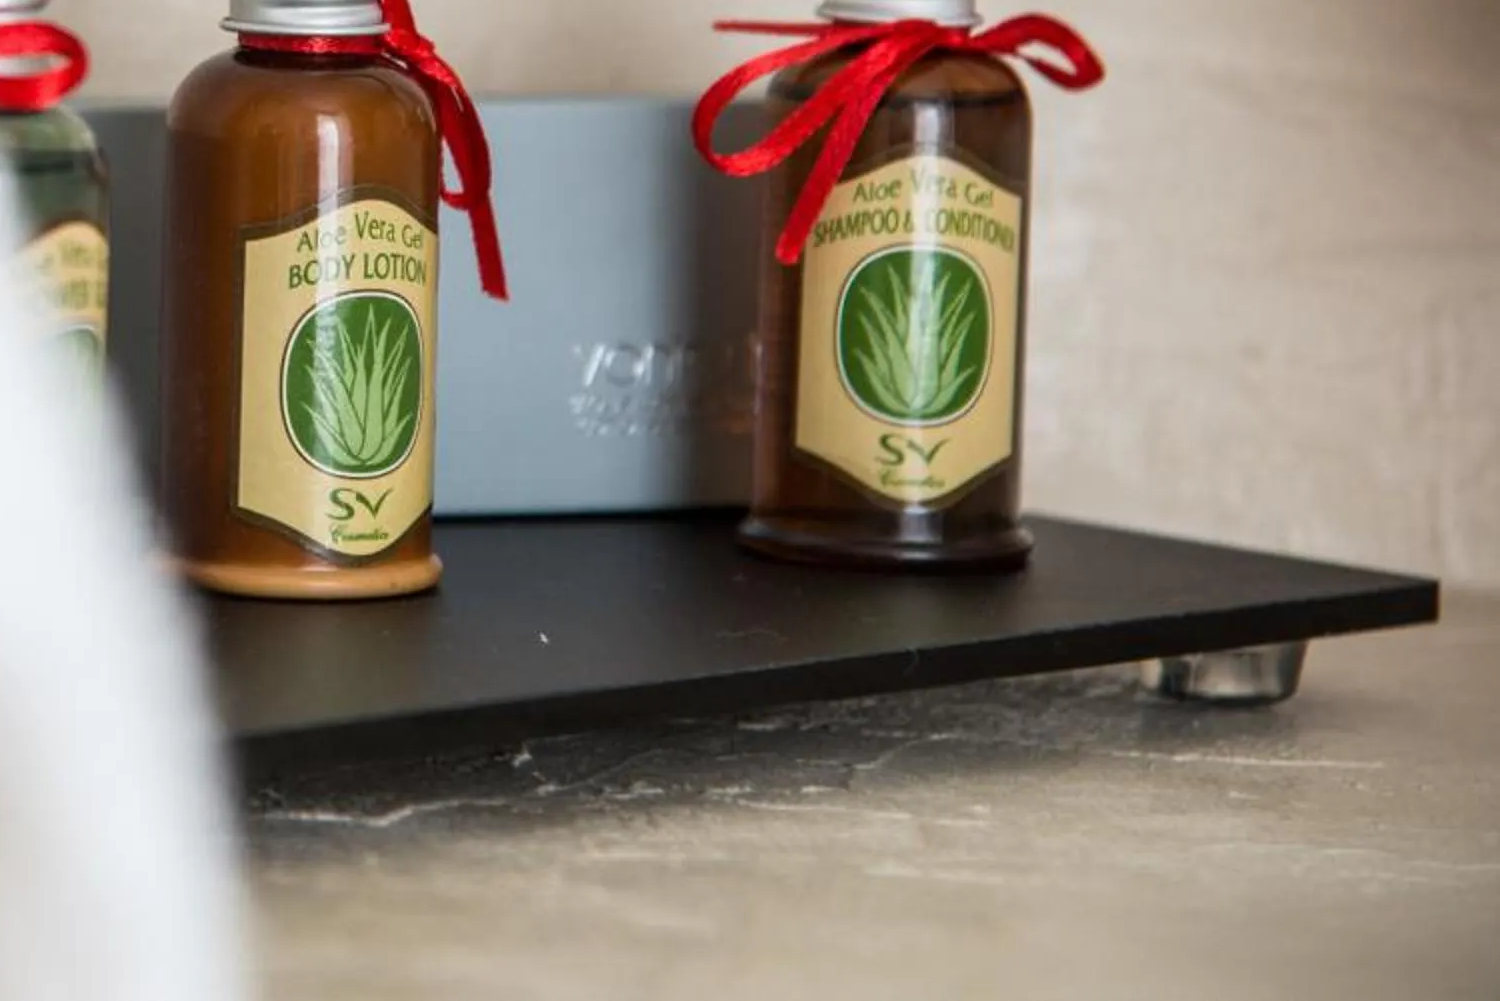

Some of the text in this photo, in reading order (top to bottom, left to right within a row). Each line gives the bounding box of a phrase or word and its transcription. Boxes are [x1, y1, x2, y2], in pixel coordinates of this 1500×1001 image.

[853, 179, 902, 202] Aloe
[964, 182, 994, 208] Gel
[297, 211, 423, 252] Aloe Vera Gel
[814, 207, 900, 247] SHAMPOO
[288, 252, 426, 289] BODY LOTION
[874, 433, 953, 466] SV
[324, 488, 394, 520] SV
